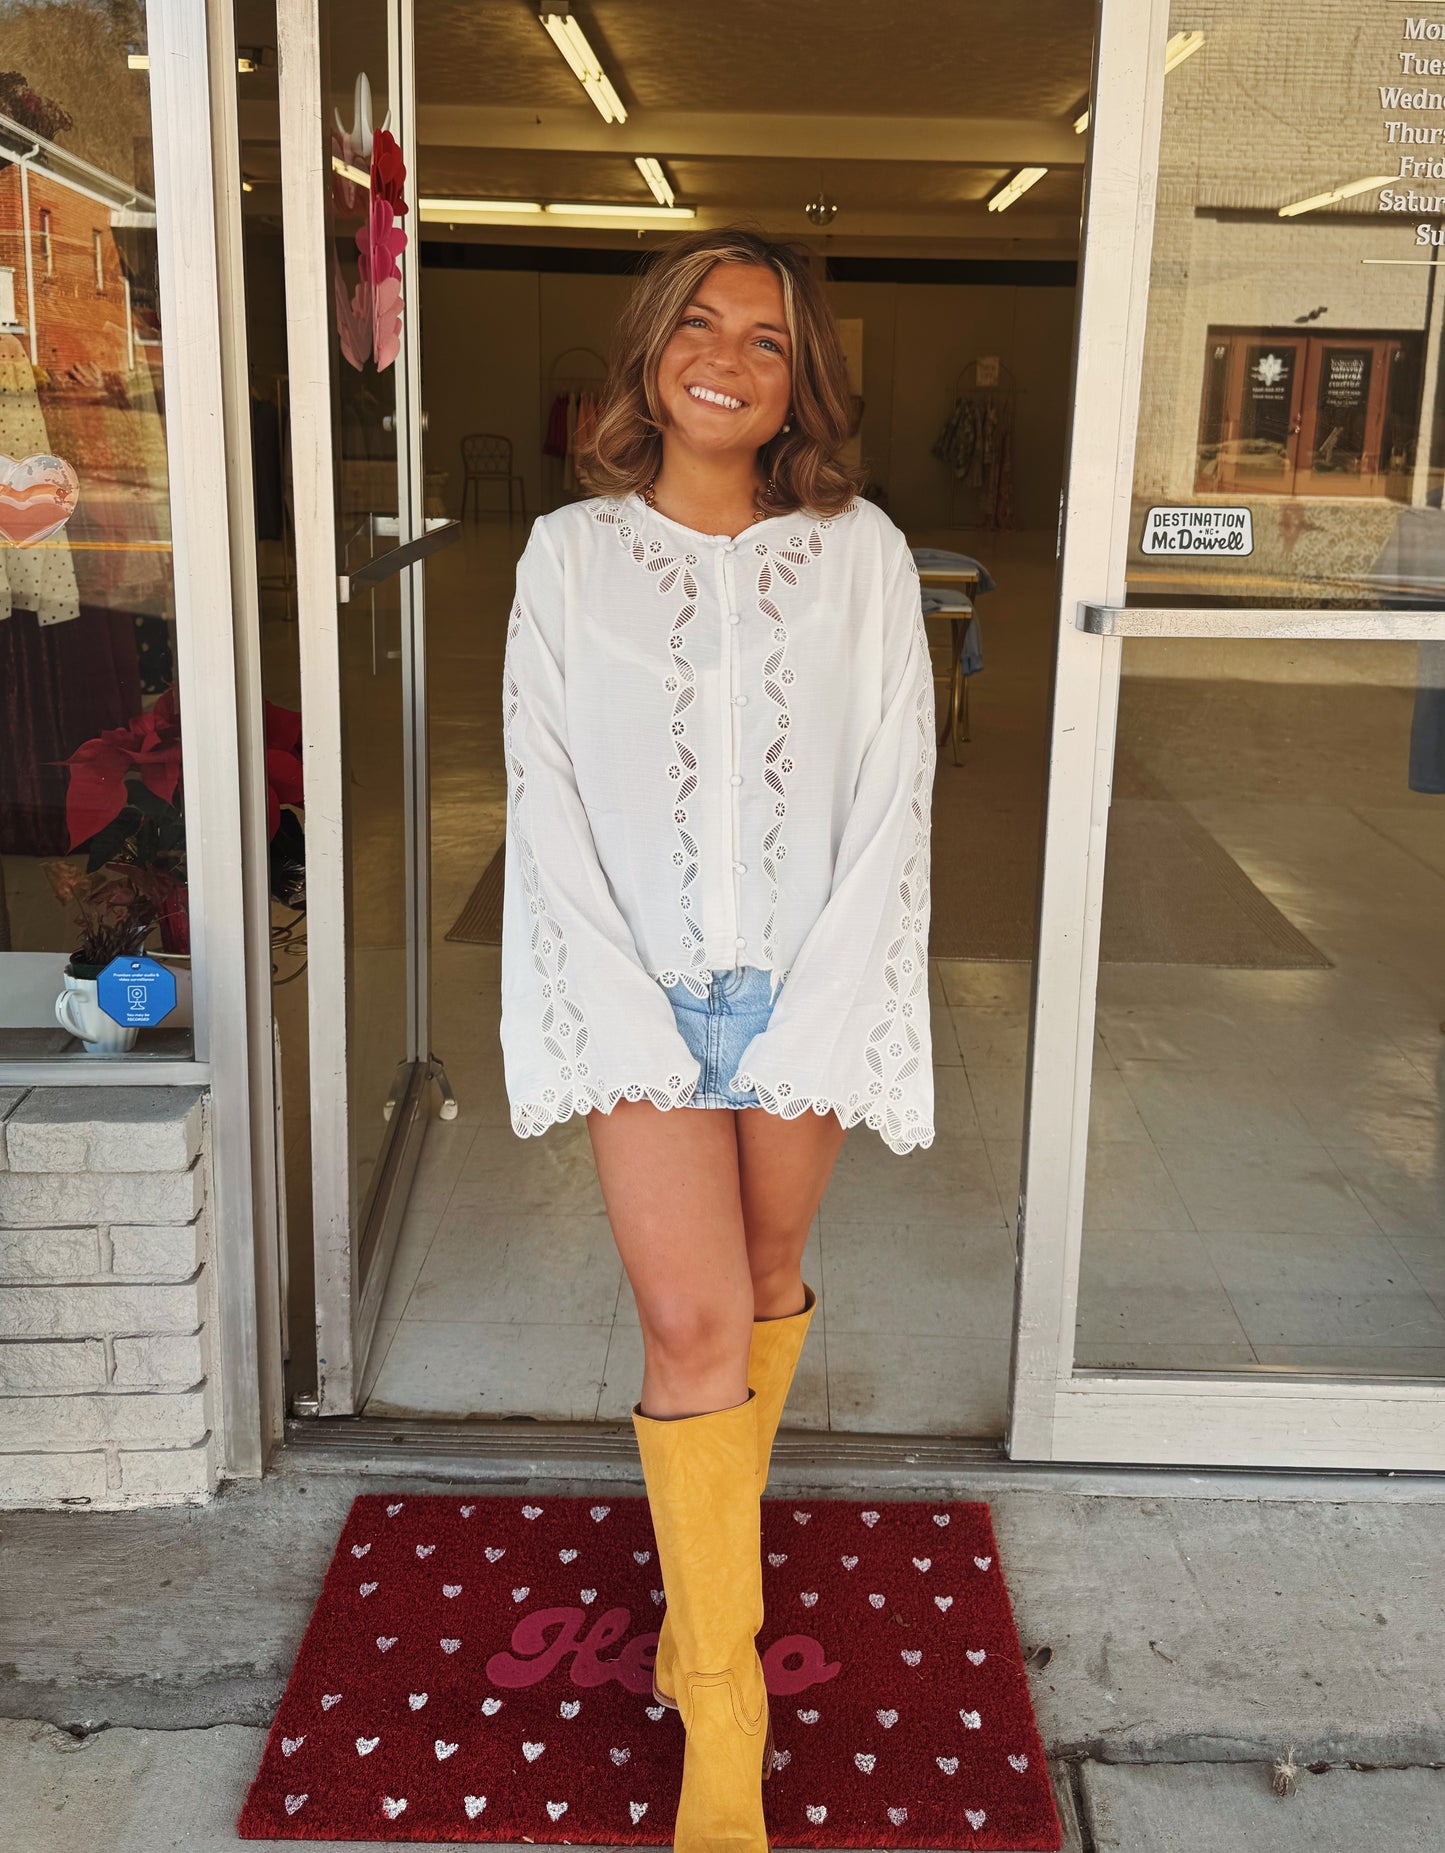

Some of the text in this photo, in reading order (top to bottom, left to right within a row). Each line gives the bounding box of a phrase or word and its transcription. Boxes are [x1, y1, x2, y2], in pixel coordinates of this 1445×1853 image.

[1399, 52, 1445, 76] Tue
[1379, 86, 1445, 110] Wedn
[1384, 121, 1445, 144] Thur
[1399, 156, 1445, 178] Frid
[1379, 189, 1445, 212] Satur
[1415, 223, 1445, 246] Su
[1153, 512, 1245, 528] DESTINATION
[1151, 529, 1244, 550] McDowell
[486, 1606, 842, 1696] Heo
